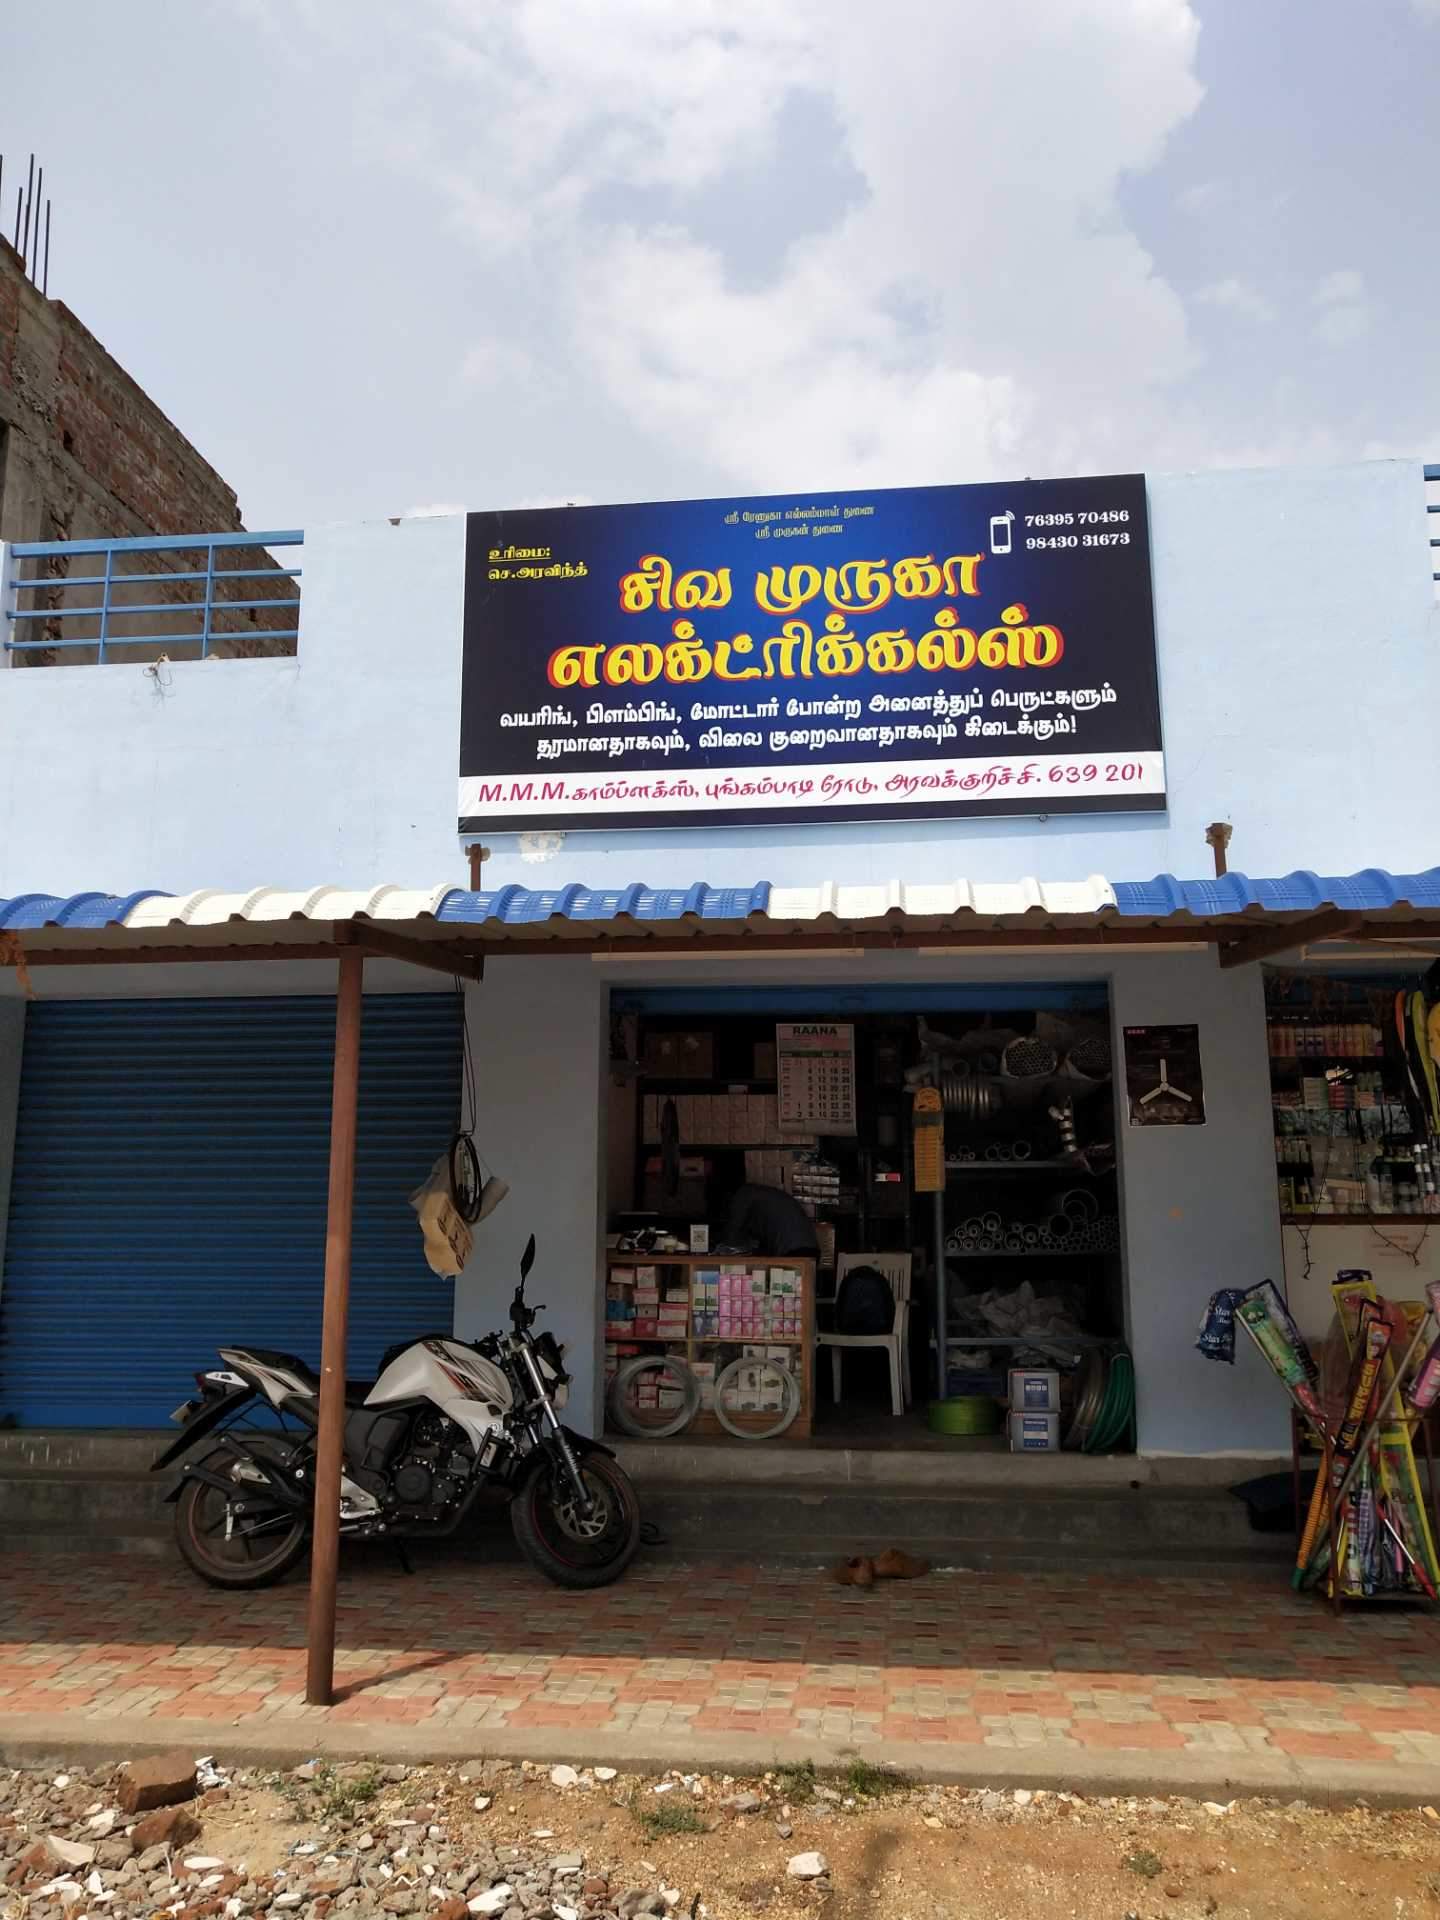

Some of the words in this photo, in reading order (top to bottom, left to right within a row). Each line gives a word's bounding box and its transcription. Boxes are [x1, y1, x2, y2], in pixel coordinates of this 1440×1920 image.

[843, 506, 874, 518] துணை
[1024, 513, 1075, 527] 76395
[1078, 510, 1130, 524] 70486
[773, 523, 809, 538] முருகன்
[812, 524, 843, 537] துணை
[1025, 535, 1079, 550] 98430
[1082, 532, 1130, 547] 31673
[488, 546, 551, 561] உரிமை:
[488, 562, 588, 580] செ.அரவிந்த்
[619, 554, 732, 613] சிவ
[754, 551, 985, 614] முருகா
[547, 603, 1064, 688] எலக்ட்ரிக்கல்ஸ்
[500, 705, 578, 727] வயரிங்,
[586, 701, 682, 725] பிளம்பிங்,
[690, 697, 779, 721] மோட்டார்
[786, 694, 861, 720] போன்ற
[868, 687, 983, 717] அனைத்துப்
[991, 682, 1117, 711] பெருட்களும்
[536, 729, 690, 759] தரமானதாகவும்,
[699, 727, 762, 748] விலை
[770, 718, 957, 750] குறைவானதாகவும்
[965, 713, 1077, 740] கிடைக்கும்!
[706, 777, 814, 800] புங்கம்பாடி
[1048, 765, 1097, 784] 639
[1106, 763, 1143, 782] 201
